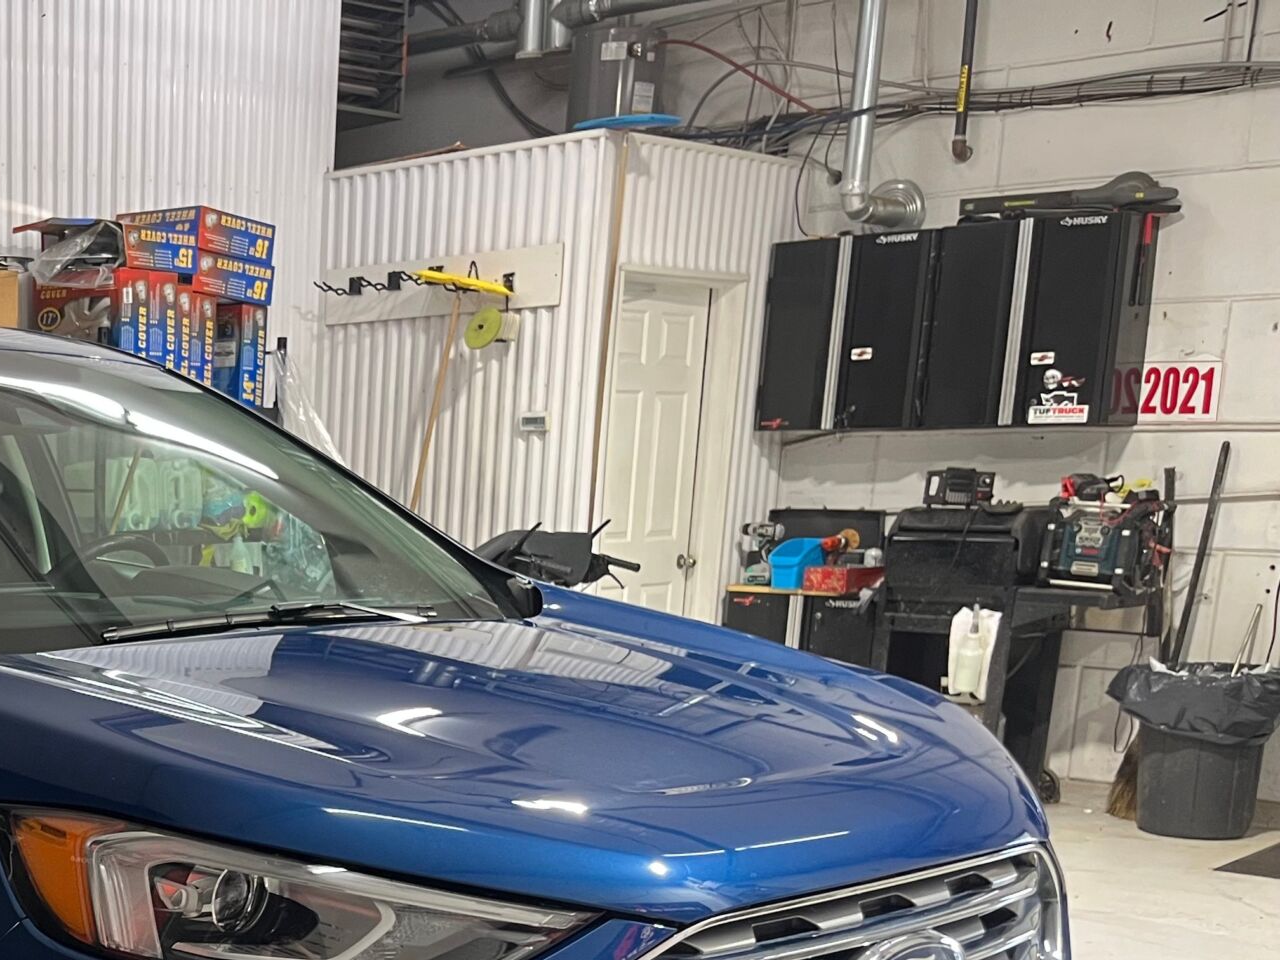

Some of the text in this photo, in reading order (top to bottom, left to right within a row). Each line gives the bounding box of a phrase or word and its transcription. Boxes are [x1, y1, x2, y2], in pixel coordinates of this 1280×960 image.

[166, 209, 196, 222] WHEEL
[220, 215, 273, 239] WHEEL COVER
[1073, 215, 1108, 226] HUSKY
[140, 229, 167, 243] COVER
[169, 233, 196, 246] WHEEL
[887, 232, 919, 243] HUSKY
[216, 258, 272, 280] WHEEL COVER
[137, 306, 148, 348] COVER
[166, 309, 175, 350] COVER
[181, 317, 190, 357] COVER
[204, 320, 214, 360] COVER
[256, 330, 265, 366] COVER
[1140, 366, 1215, 415] 2021
